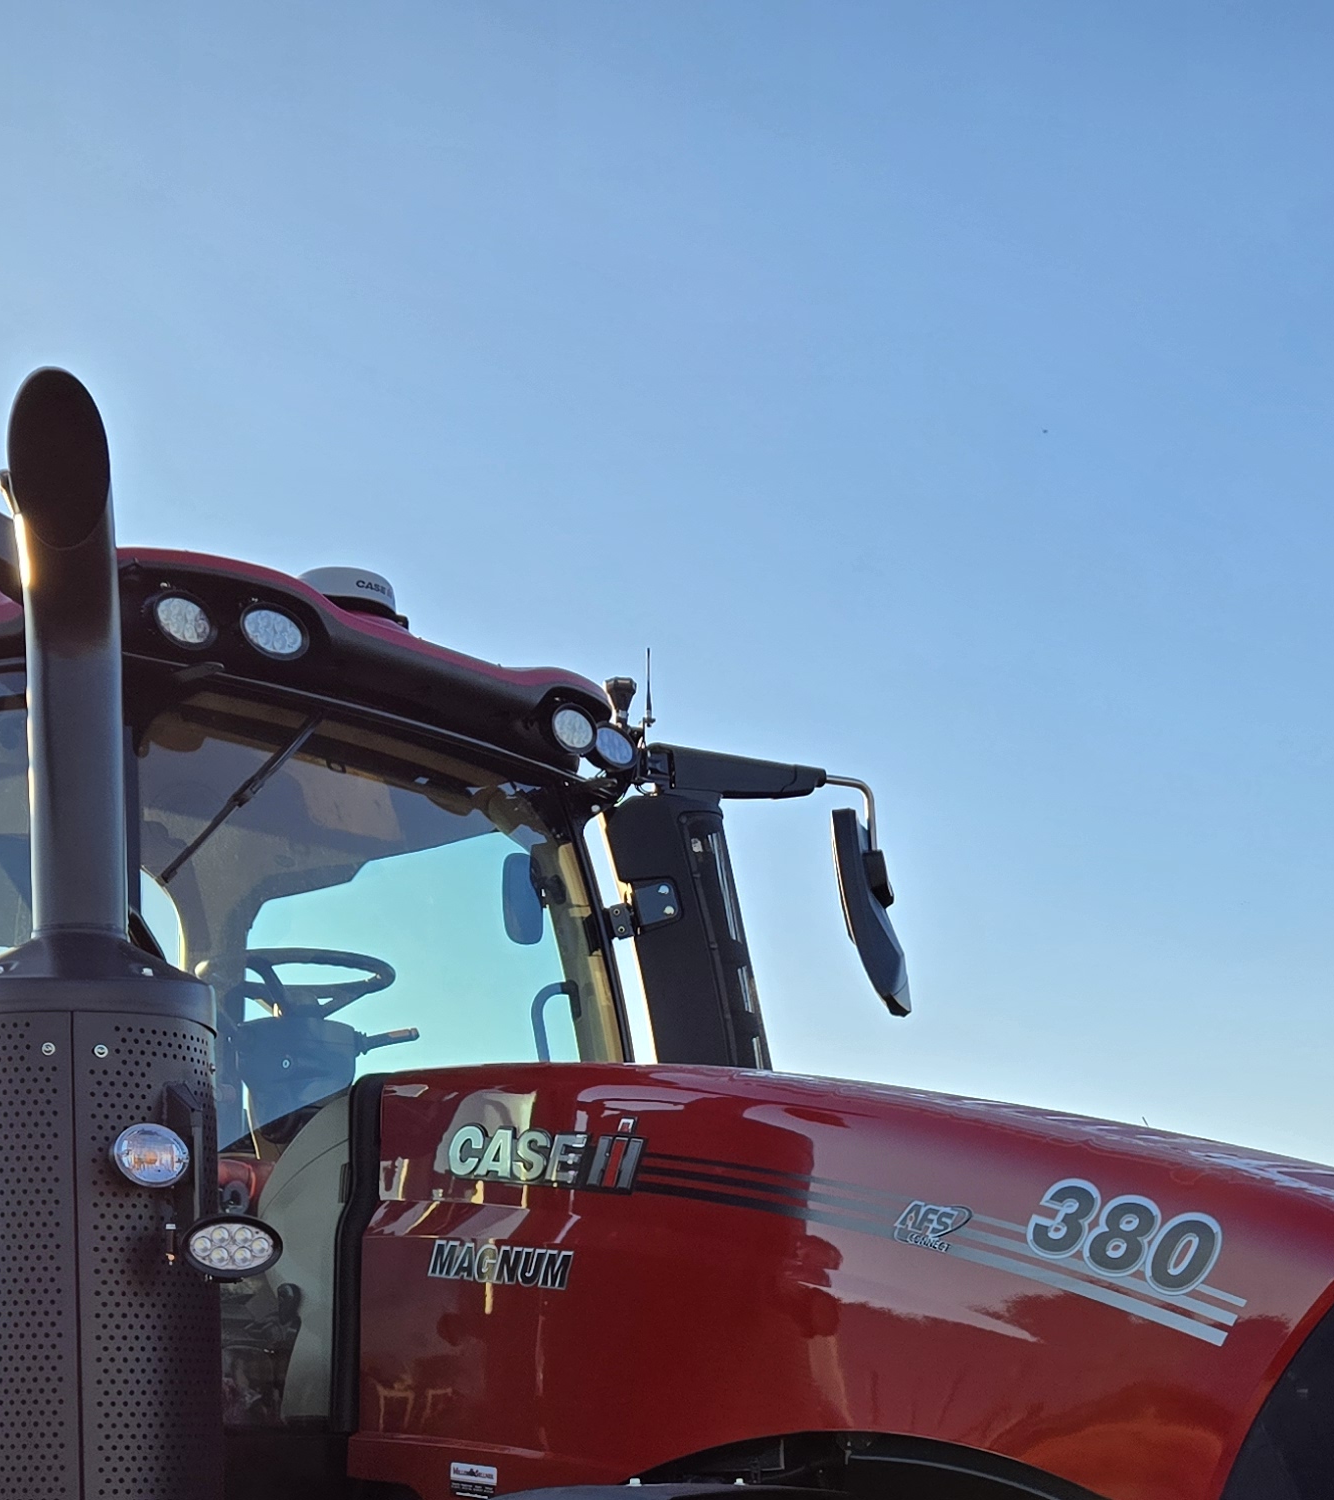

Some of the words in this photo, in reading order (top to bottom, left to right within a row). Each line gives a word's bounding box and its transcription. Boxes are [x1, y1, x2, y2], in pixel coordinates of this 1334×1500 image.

[448, 1122, 589, 1184] CASE
[893, 1200, 959, 1235] AFS
[908, 1233, 951, 1253] CONNECT
[1026, 1177, 1223, 1296] 380
[427, 1239, 574, 1290] MAGNUM
